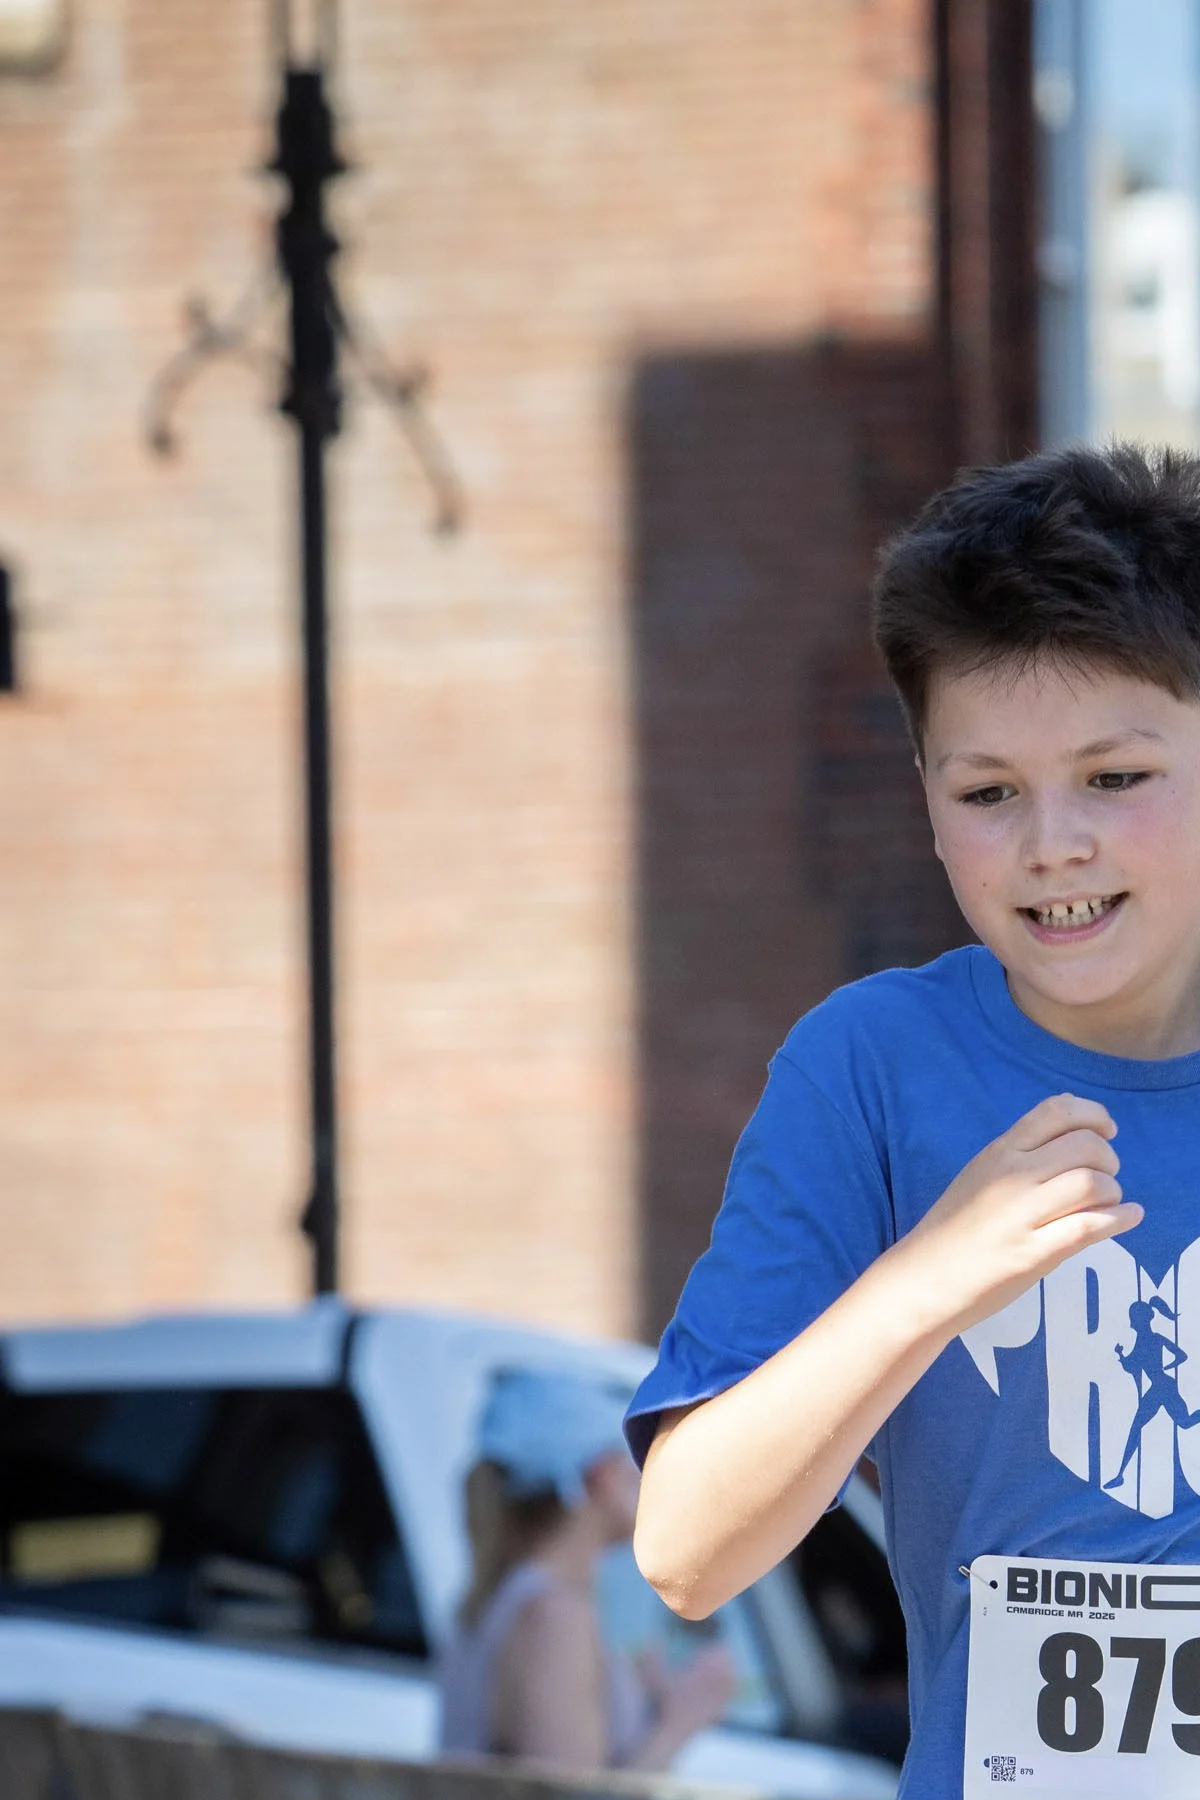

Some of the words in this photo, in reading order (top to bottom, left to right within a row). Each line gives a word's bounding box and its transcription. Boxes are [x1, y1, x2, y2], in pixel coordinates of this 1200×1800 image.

[1006, 1606, 1064, 1616] CAMBRIDGE
[1067, 1610, 1084, 1619] MA
[1088, 1612, 1115, 1620] 2026
[1019, 1767, 1034, 1776] 879
